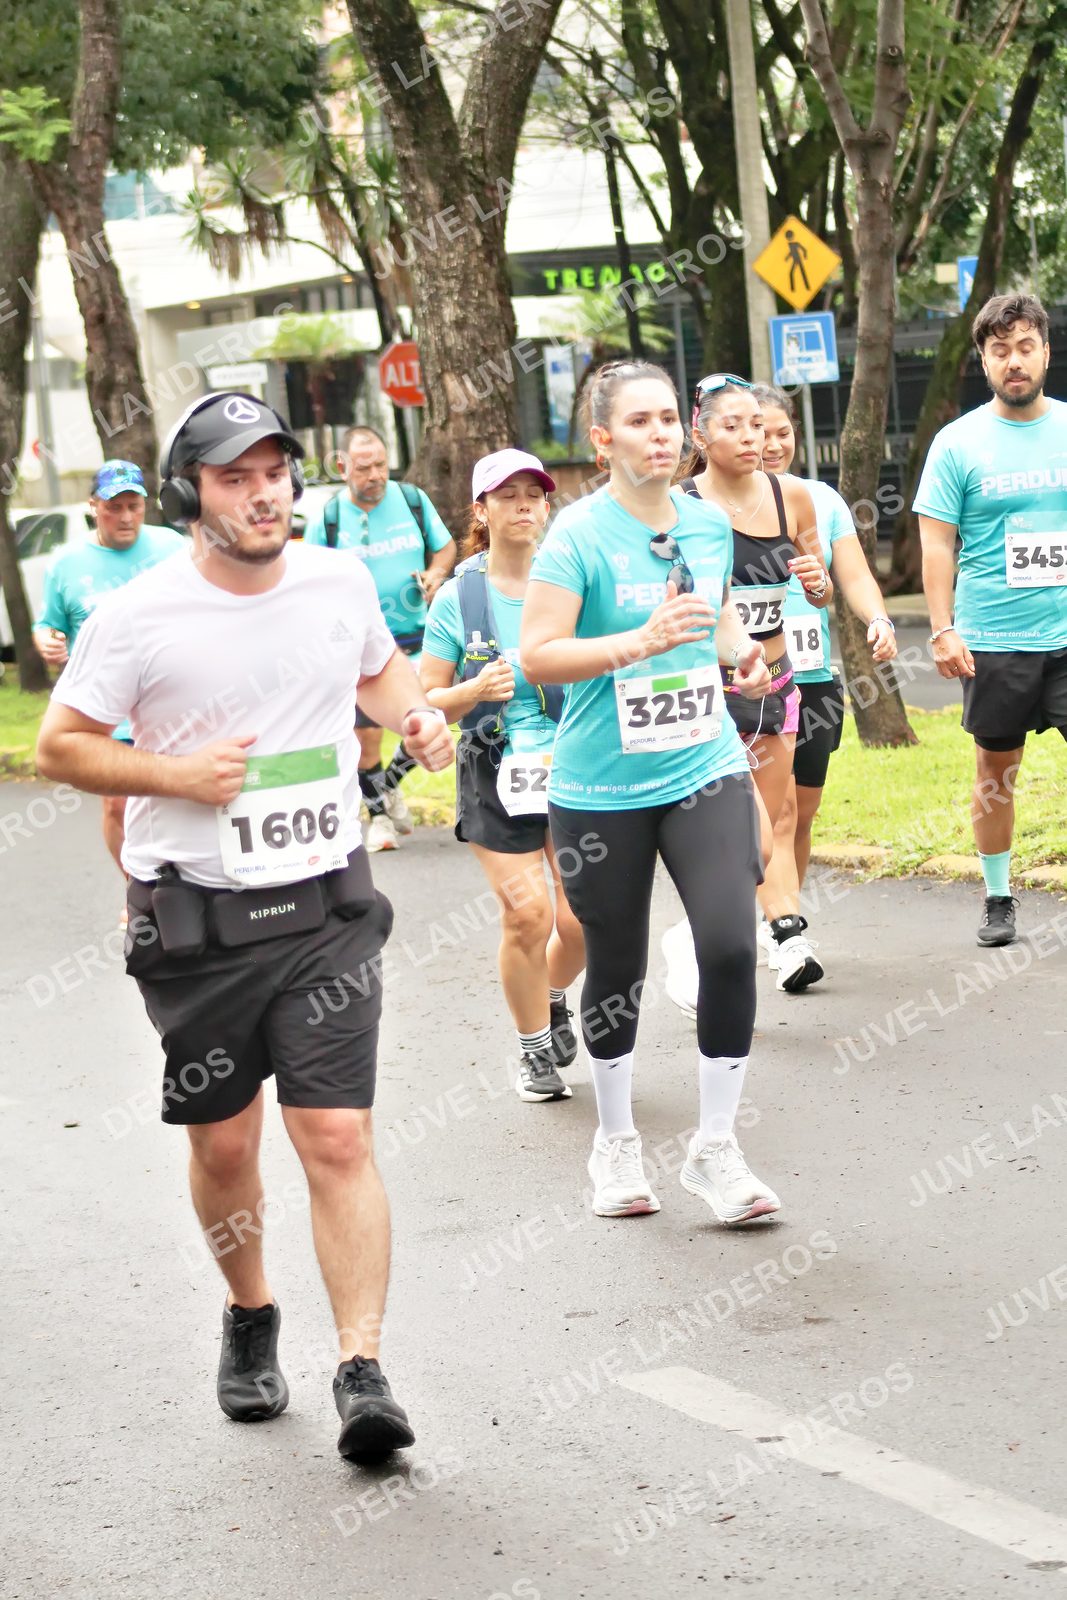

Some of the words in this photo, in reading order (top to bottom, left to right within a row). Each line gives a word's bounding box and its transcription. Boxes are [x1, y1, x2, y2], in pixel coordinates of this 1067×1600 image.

[1012, 546, 1067, 569] 345
[625, 685, 715, 728] 3257
[630, 737, 656, 745] PERDURA
[586, 785, 592, 794] y
[594, 783, 627, 793] amigos
[231, 802, 340, 854] 1606
[250, 902, 296, 920] KIPRUN
